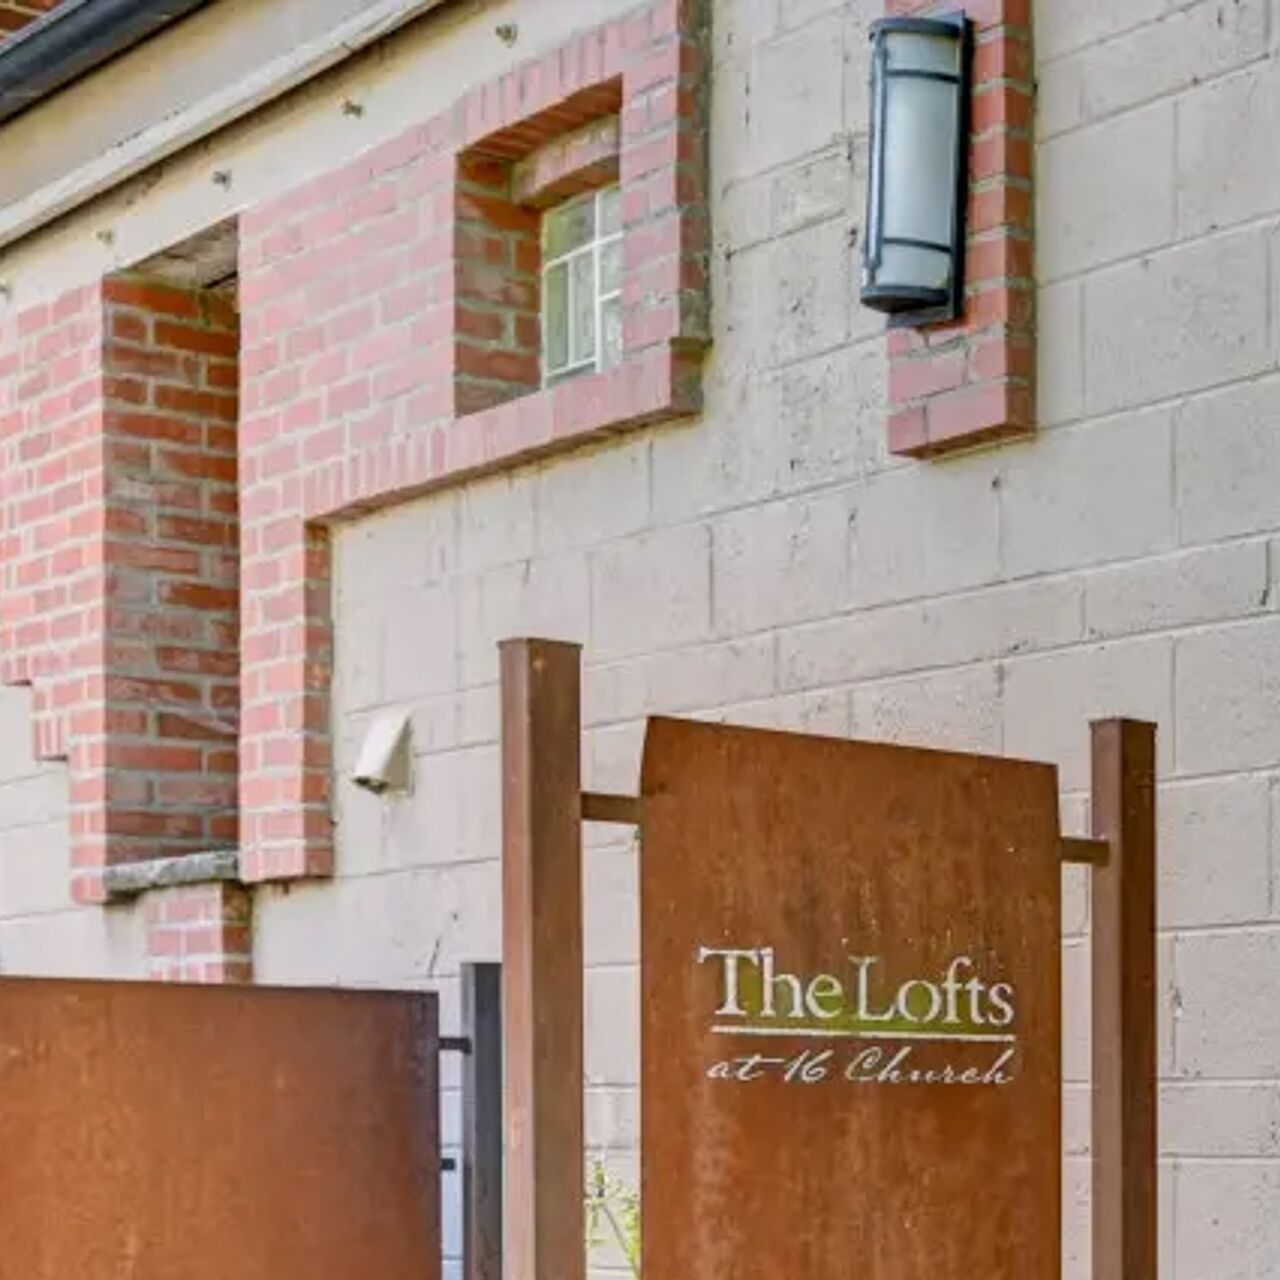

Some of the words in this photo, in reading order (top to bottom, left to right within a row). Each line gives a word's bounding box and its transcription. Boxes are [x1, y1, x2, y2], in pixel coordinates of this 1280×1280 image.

[706, 1053, 784, 1082] at
[783, 1049, 834, 1083] 16
[844, 1046, 1014, 1085] Church
